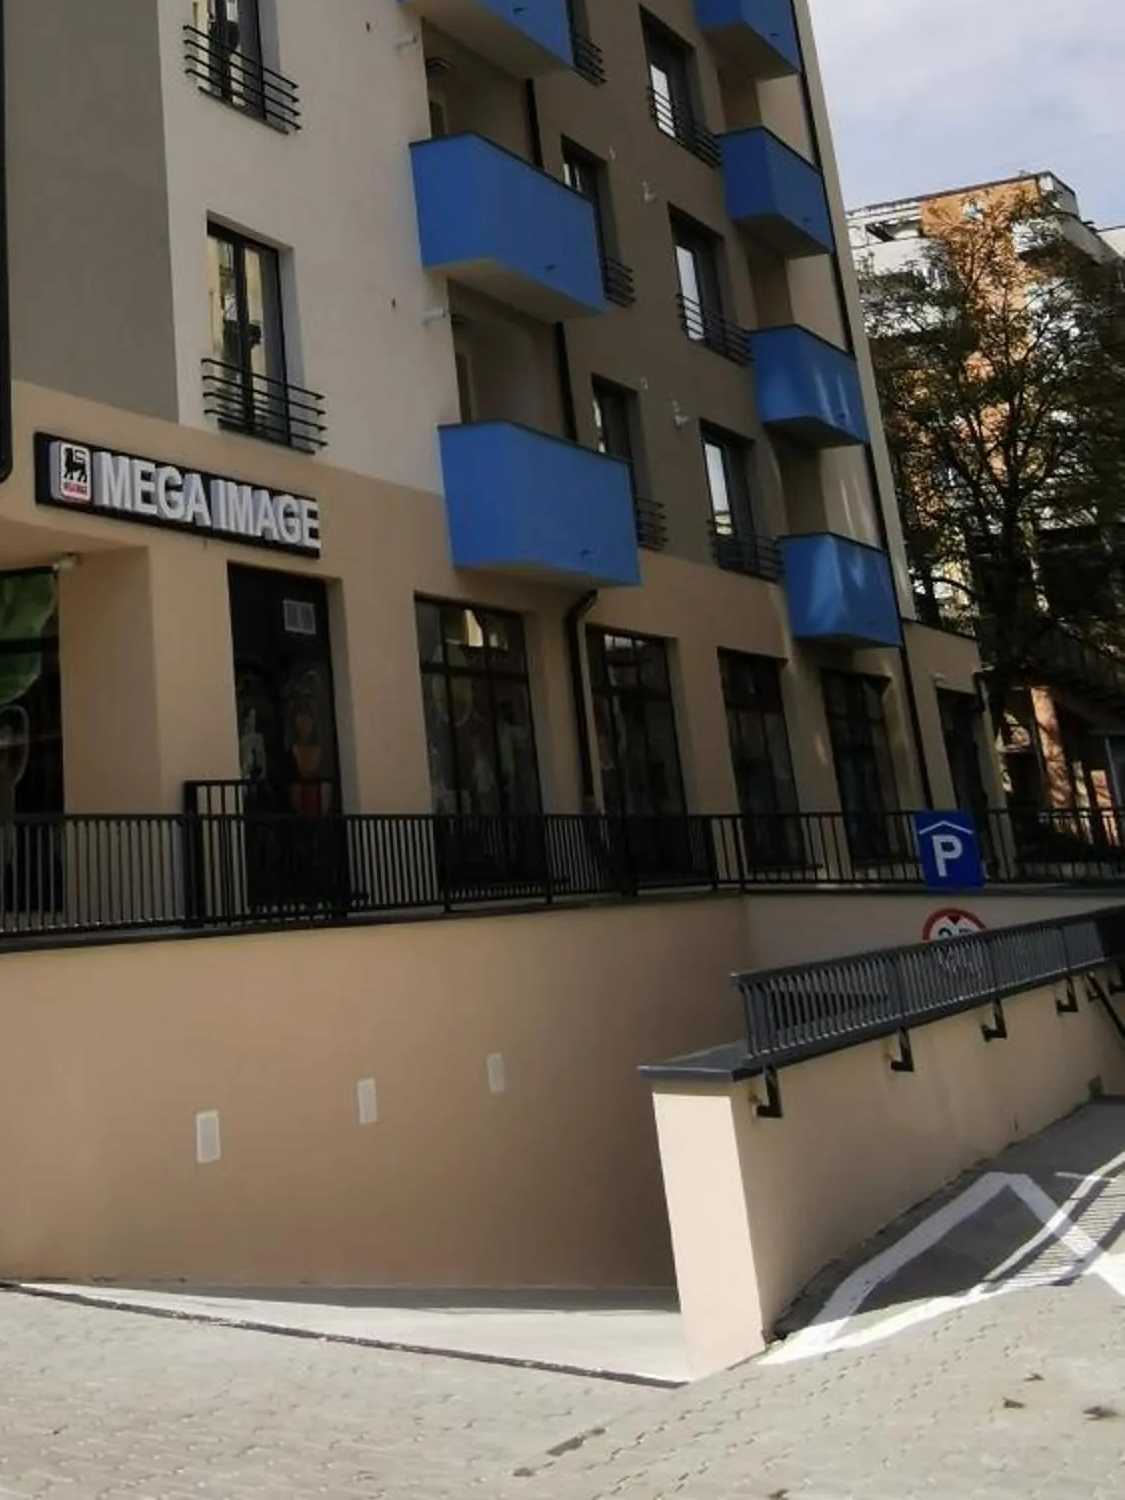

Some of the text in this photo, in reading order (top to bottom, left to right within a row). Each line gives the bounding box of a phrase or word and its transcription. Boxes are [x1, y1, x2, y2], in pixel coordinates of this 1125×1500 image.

[96, 451, 321, 549] MEGA IMAGE
[931, 833, 963, 877] P
